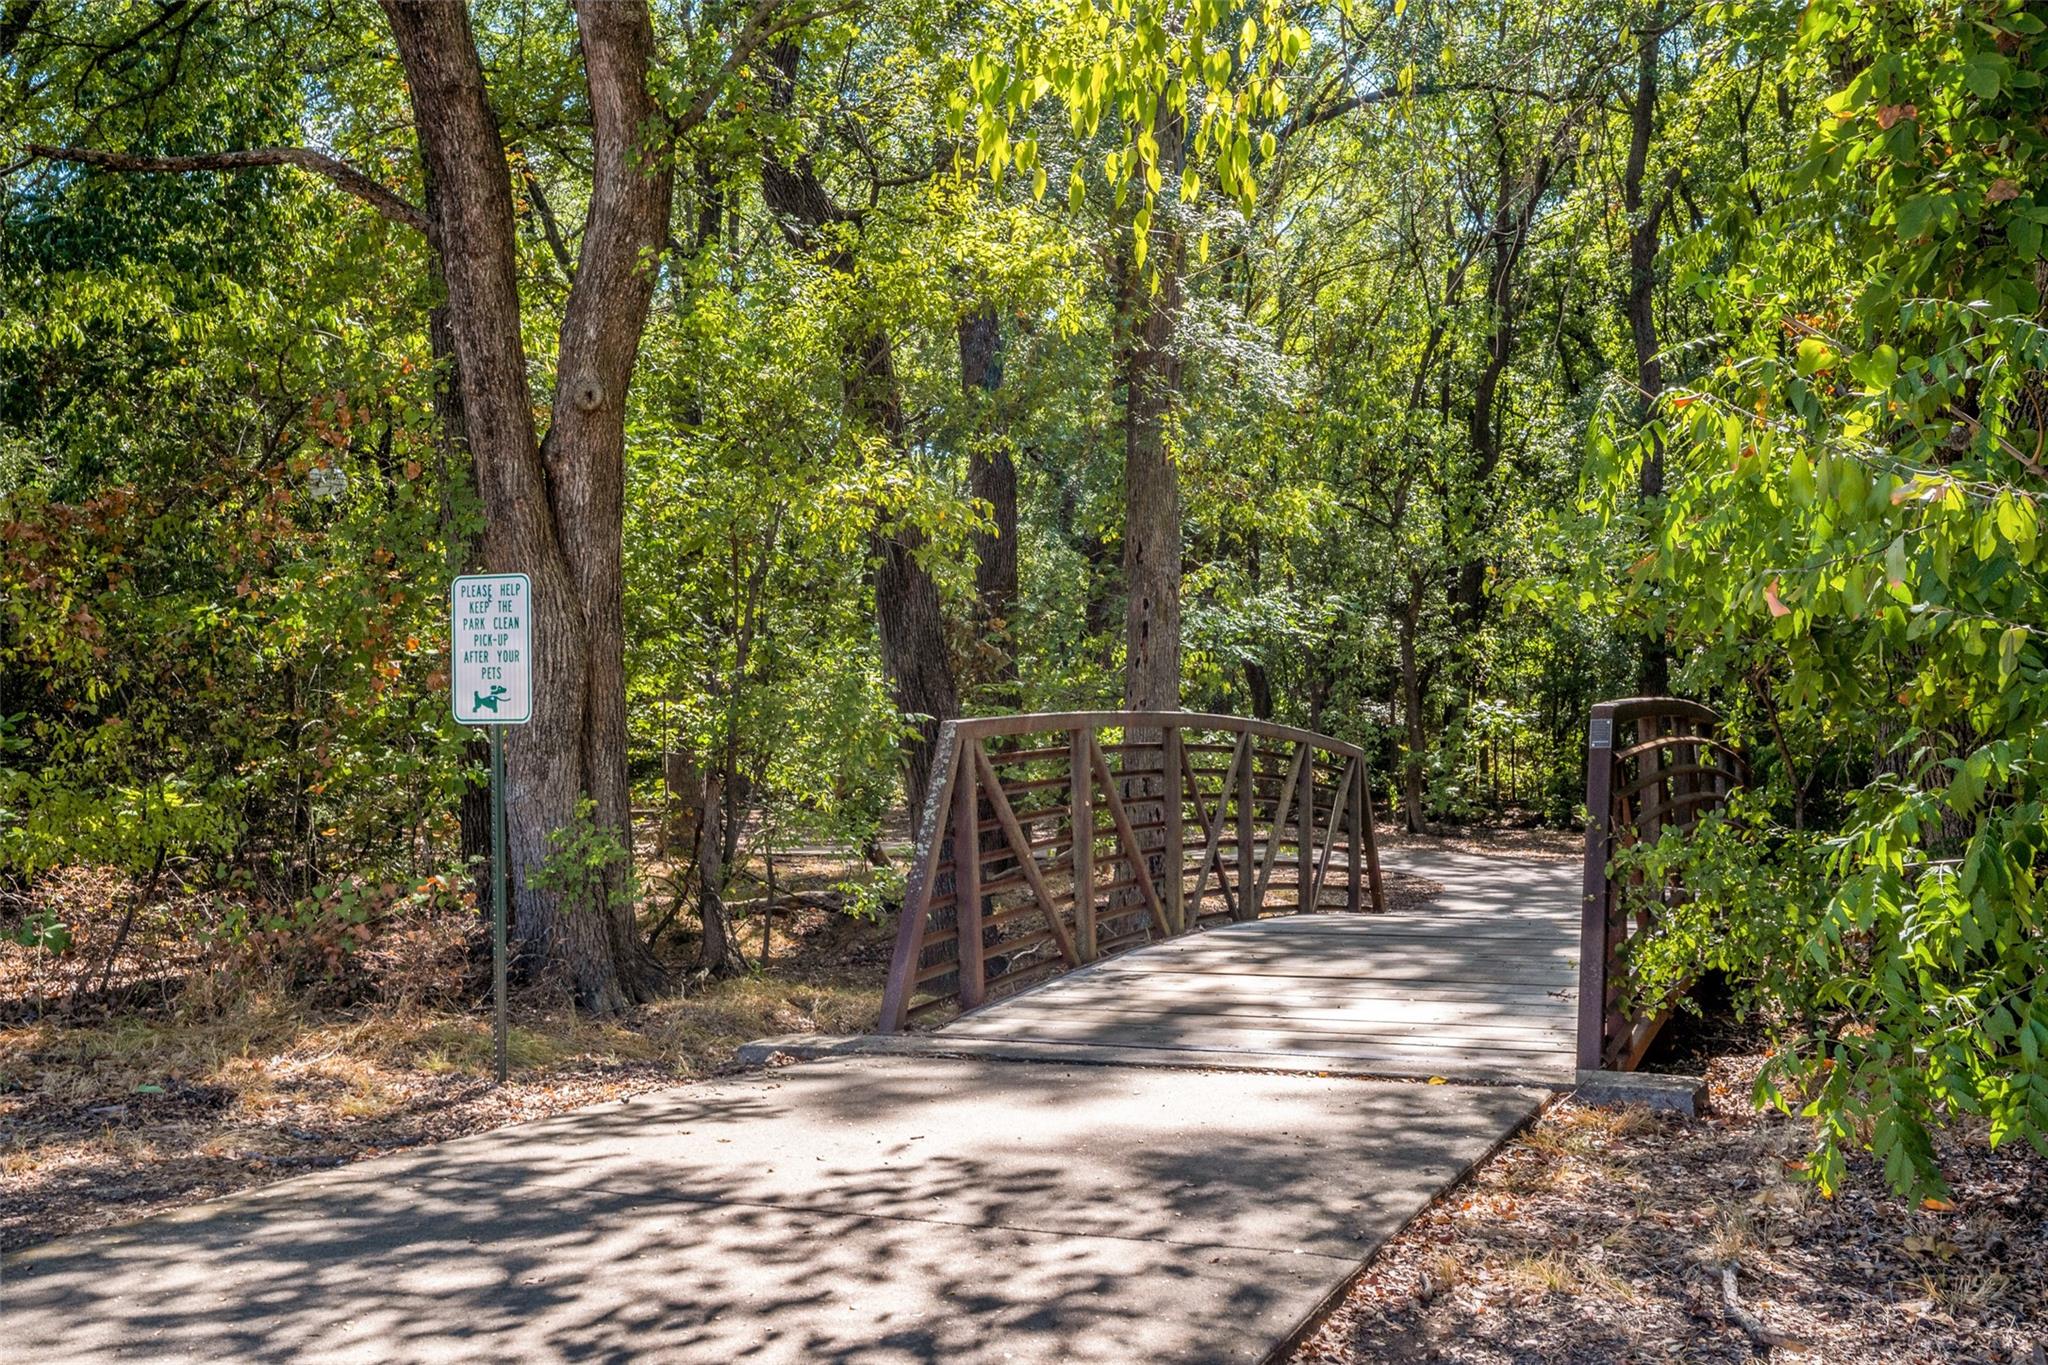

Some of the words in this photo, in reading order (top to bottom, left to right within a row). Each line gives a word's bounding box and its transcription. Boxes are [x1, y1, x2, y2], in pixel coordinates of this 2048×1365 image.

[461, 584, 492, 598] PLEASE
[500, 583, 521, 597] HELP
[469, 601, 490, 614] KEEP
[498, 600, 513, 613] THE
[463, 617, 485, 630] PARK
[493, 617, 520, 629] CLEAN
[474, 634, 509, 647] PICK-UP
[463, 650, 489, 663] AFTER
[497, 650, 520, 663] YOUR
[481, 667, 502, 680] PETS
